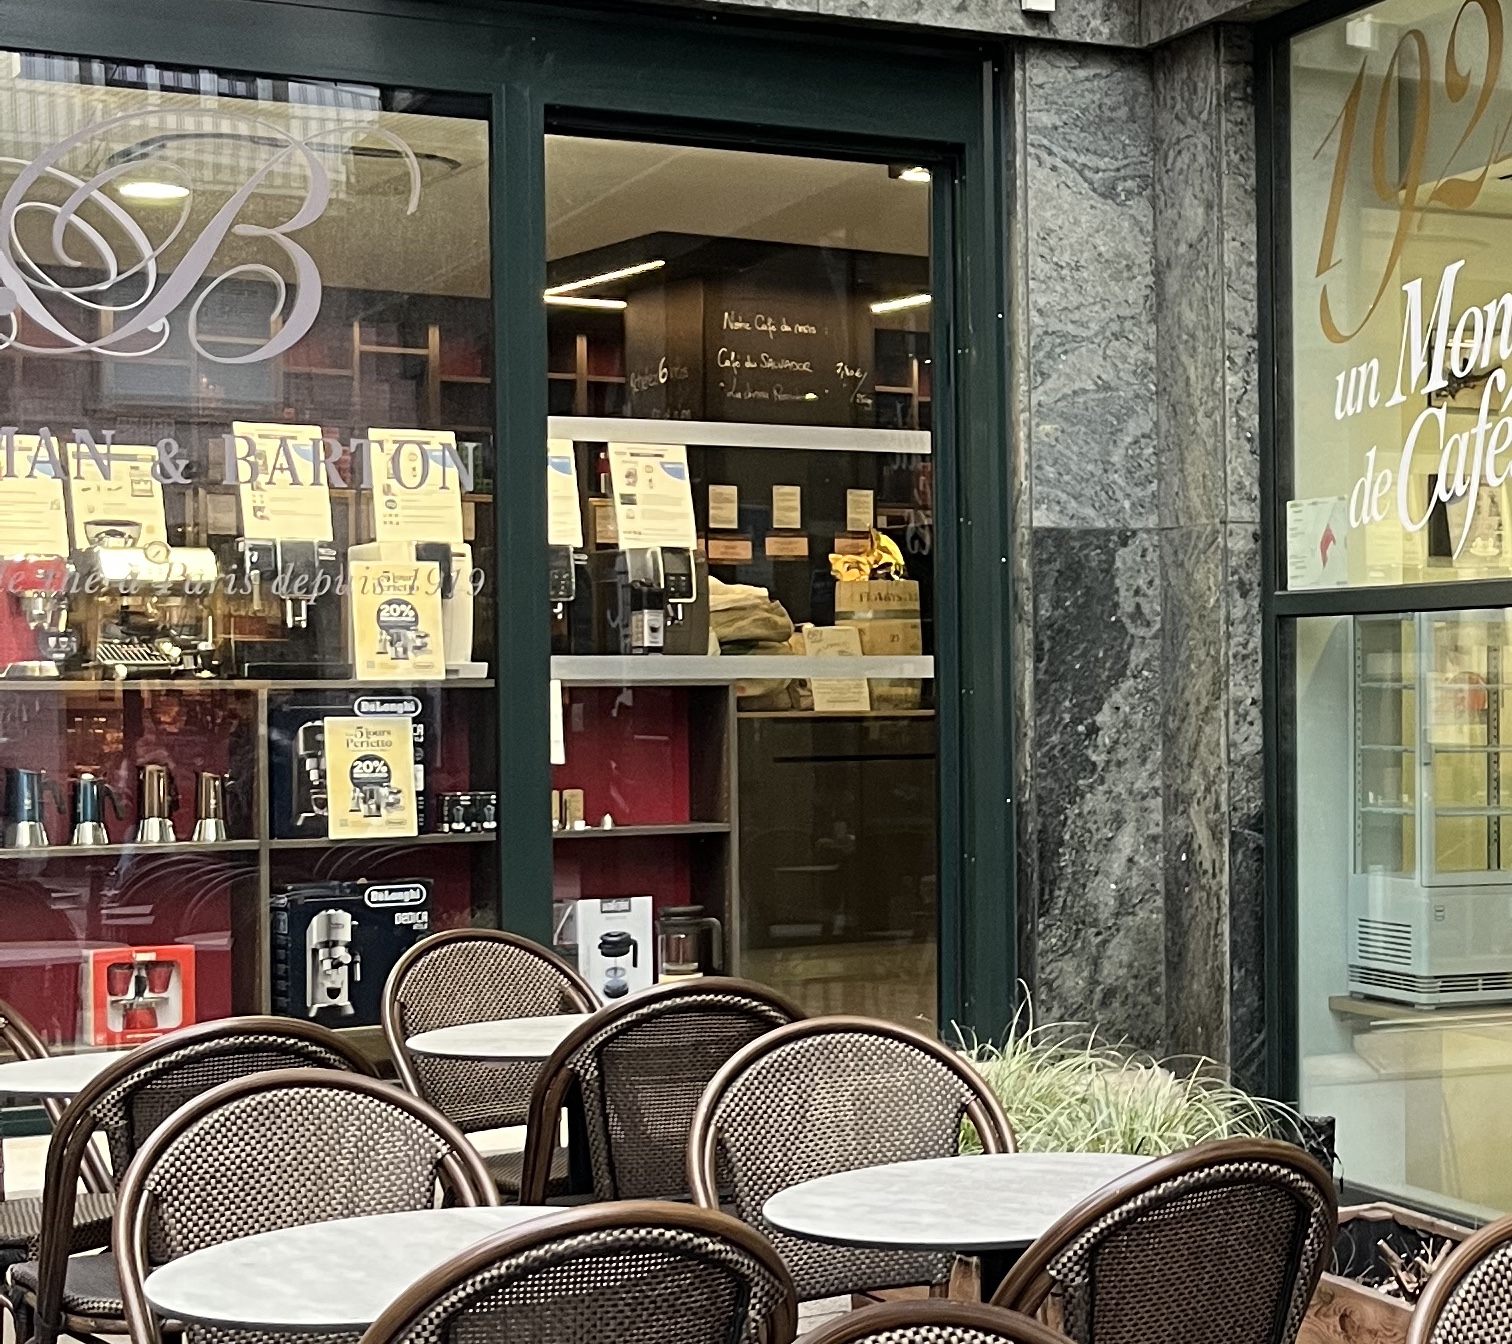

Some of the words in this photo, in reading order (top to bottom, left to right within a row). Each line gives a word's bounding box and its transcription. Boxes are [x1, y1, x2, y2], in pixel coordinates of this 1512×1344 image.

[1334, 356, 1382, 422] un
[151, 438, 192, 485] &
[220, 433, 483, 492] BARTON
[1348, 445, 1394, 531] de
[405, 566, 487, 598] 1919
[379, 603, 416, 617] 20%
[352, 759, 389, 774] 20%
